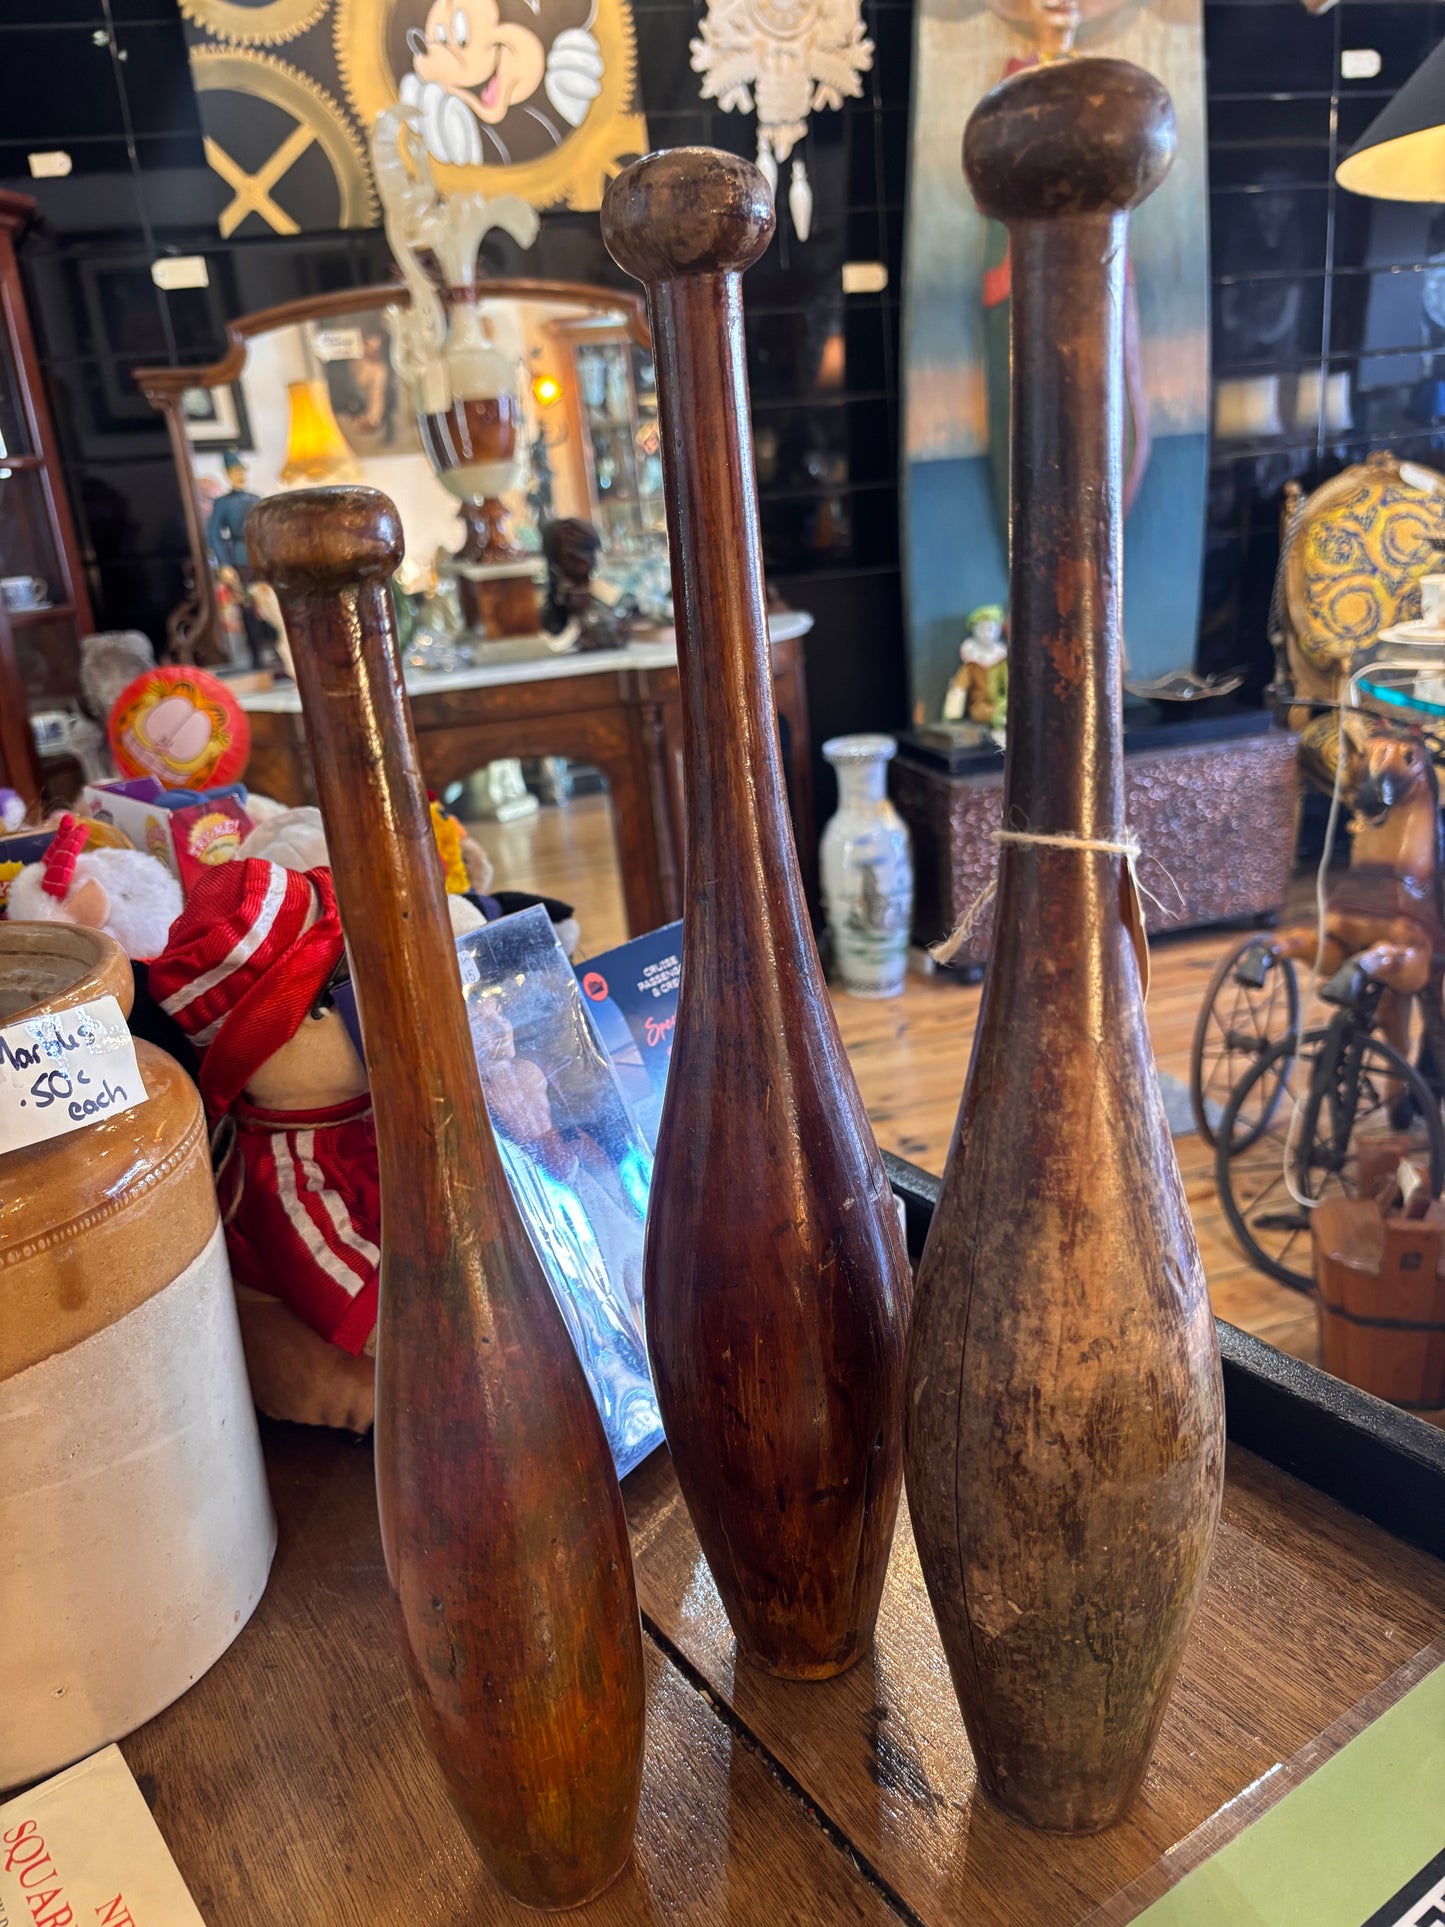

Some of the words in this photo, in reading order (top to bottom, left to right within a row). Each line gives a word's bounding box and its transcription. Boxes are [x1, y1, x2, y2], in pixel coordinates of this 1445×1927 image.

[637, 963, 681, 992] PASSENG
[643, 954, 679, 978] CRUISE
[68, 1079, 128, 1121] each
[3, 1819, 79, 1927] SQUAR
